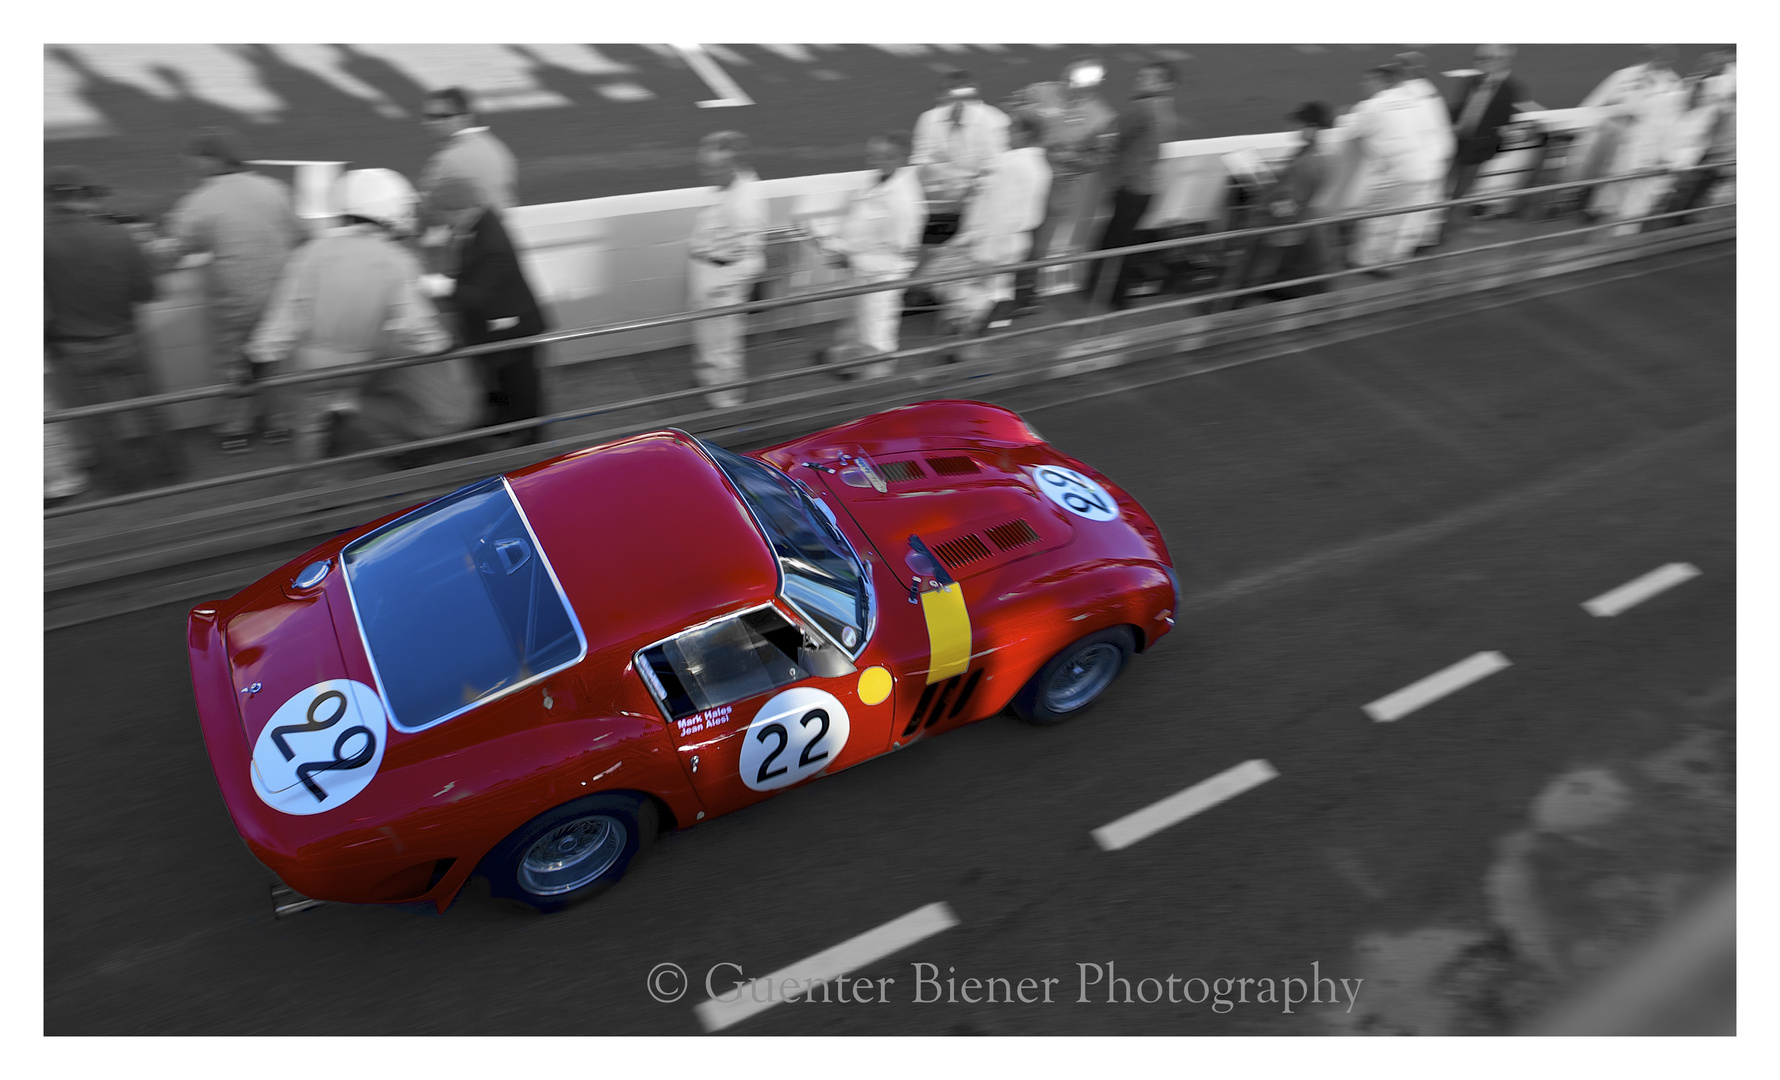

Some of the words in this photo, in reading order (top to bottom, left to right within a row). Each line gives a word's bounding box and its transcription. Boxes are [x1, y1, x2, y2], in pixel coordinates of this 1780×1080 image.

[1041, 469, 1113, 514] 22
[677, 714, 703, 730] Mark
[704, 705, 732, 720] Hales
[680, 723, 704, 737] Jean
[706, 713, 730, 729] Alesi
[270, 690, 376, 803] 22
[756, 708, 830, 784] 22
